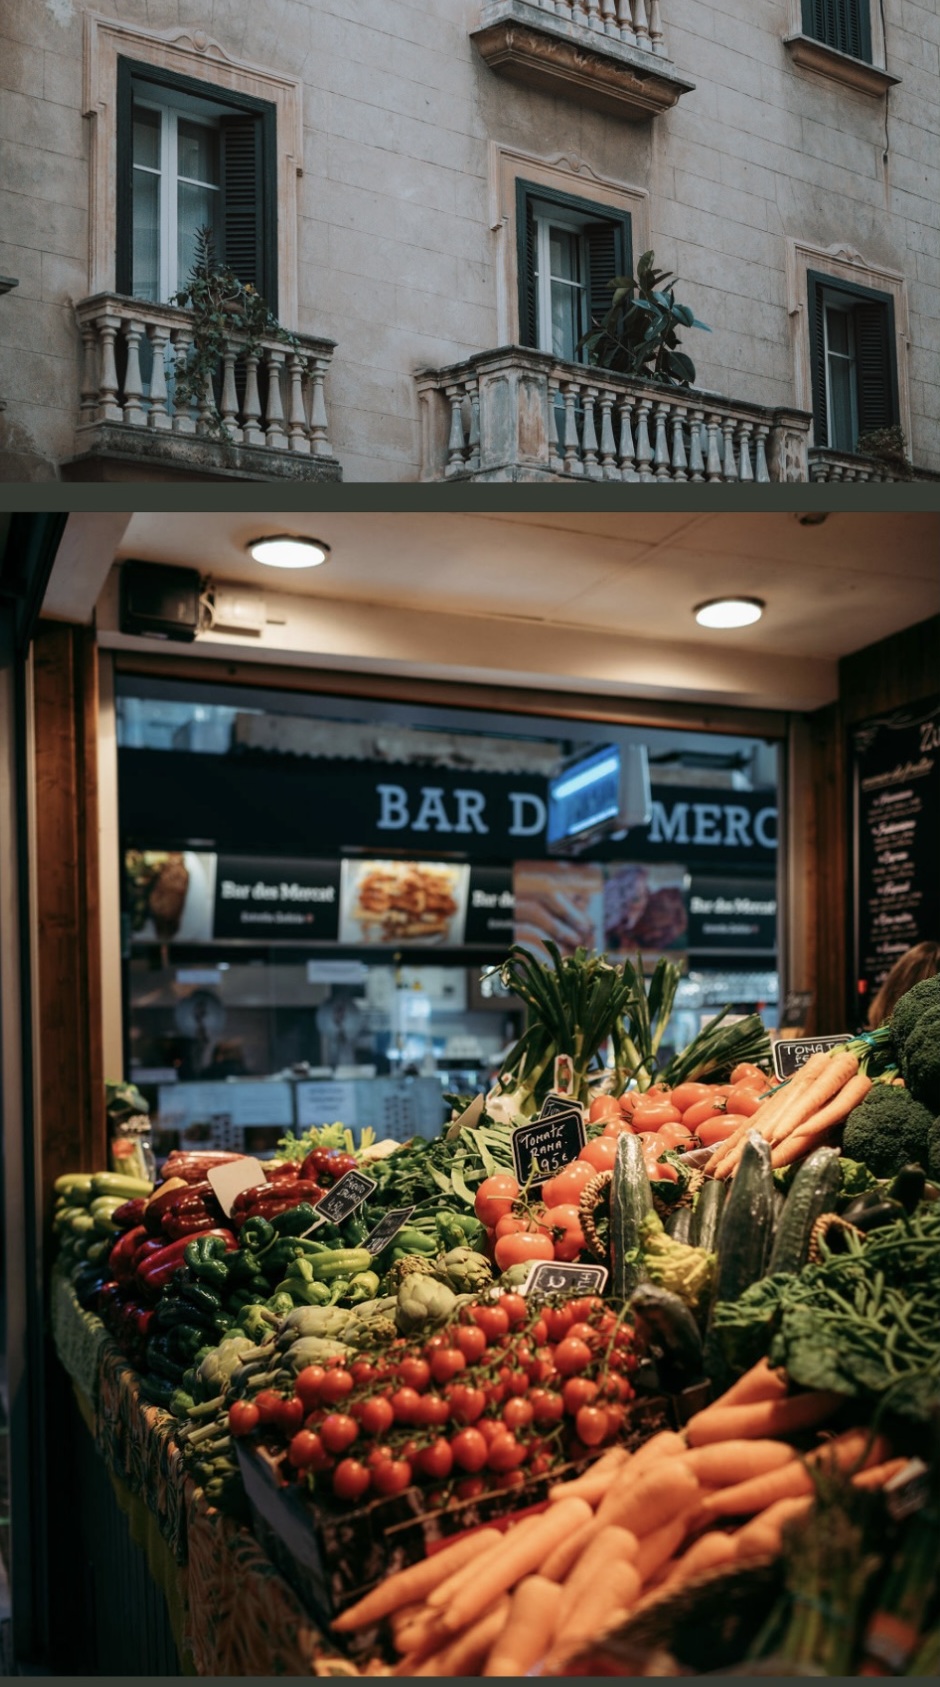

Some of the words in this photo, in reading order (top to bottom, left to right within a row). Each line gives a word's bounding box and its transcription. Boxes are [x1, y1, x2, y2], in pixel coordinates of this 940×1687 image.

[376, 784, 489, 834] BAR
[221, 880, 250, 899] Bar
[280, 882, 335, 902] Mercat
[472, 890, 497, 907] Bar
[690, 896, 713, 914] Bar
